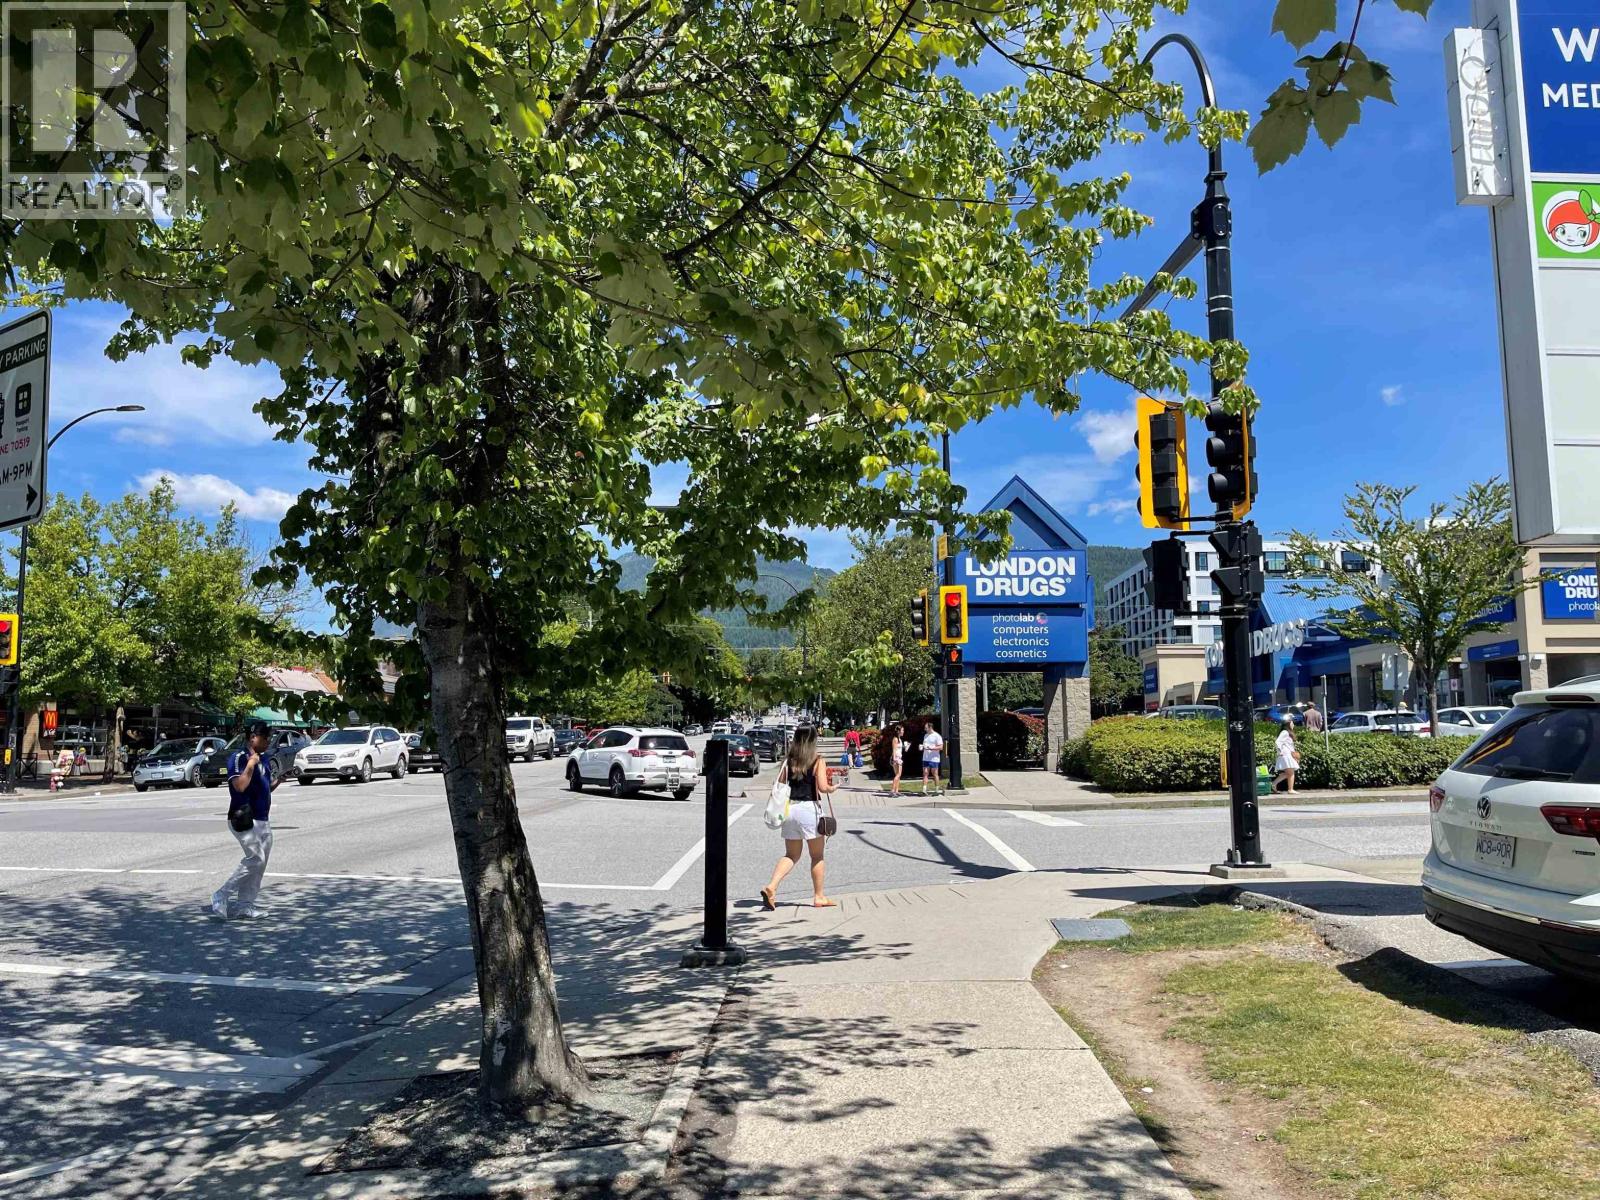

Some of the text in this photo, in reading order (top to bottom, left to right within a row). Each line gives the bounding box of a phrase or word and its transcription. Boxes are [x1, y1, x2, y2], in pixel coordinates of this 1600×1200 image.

[5, 337, 46, 367] PARKING
[11, 436, 31, 451] 70519
[0, 460, 33, 485] M-9PM
[965, 556, 1076, 576] LONDON
[992, 612, 1035, 624] photolab
[993, 625, 1049, 636] computers
[1253, 618, 1305, 657] DRUGS
[993, 636, 1050, 647] electronics
[995, 649, 1047, 659] cosmetics
